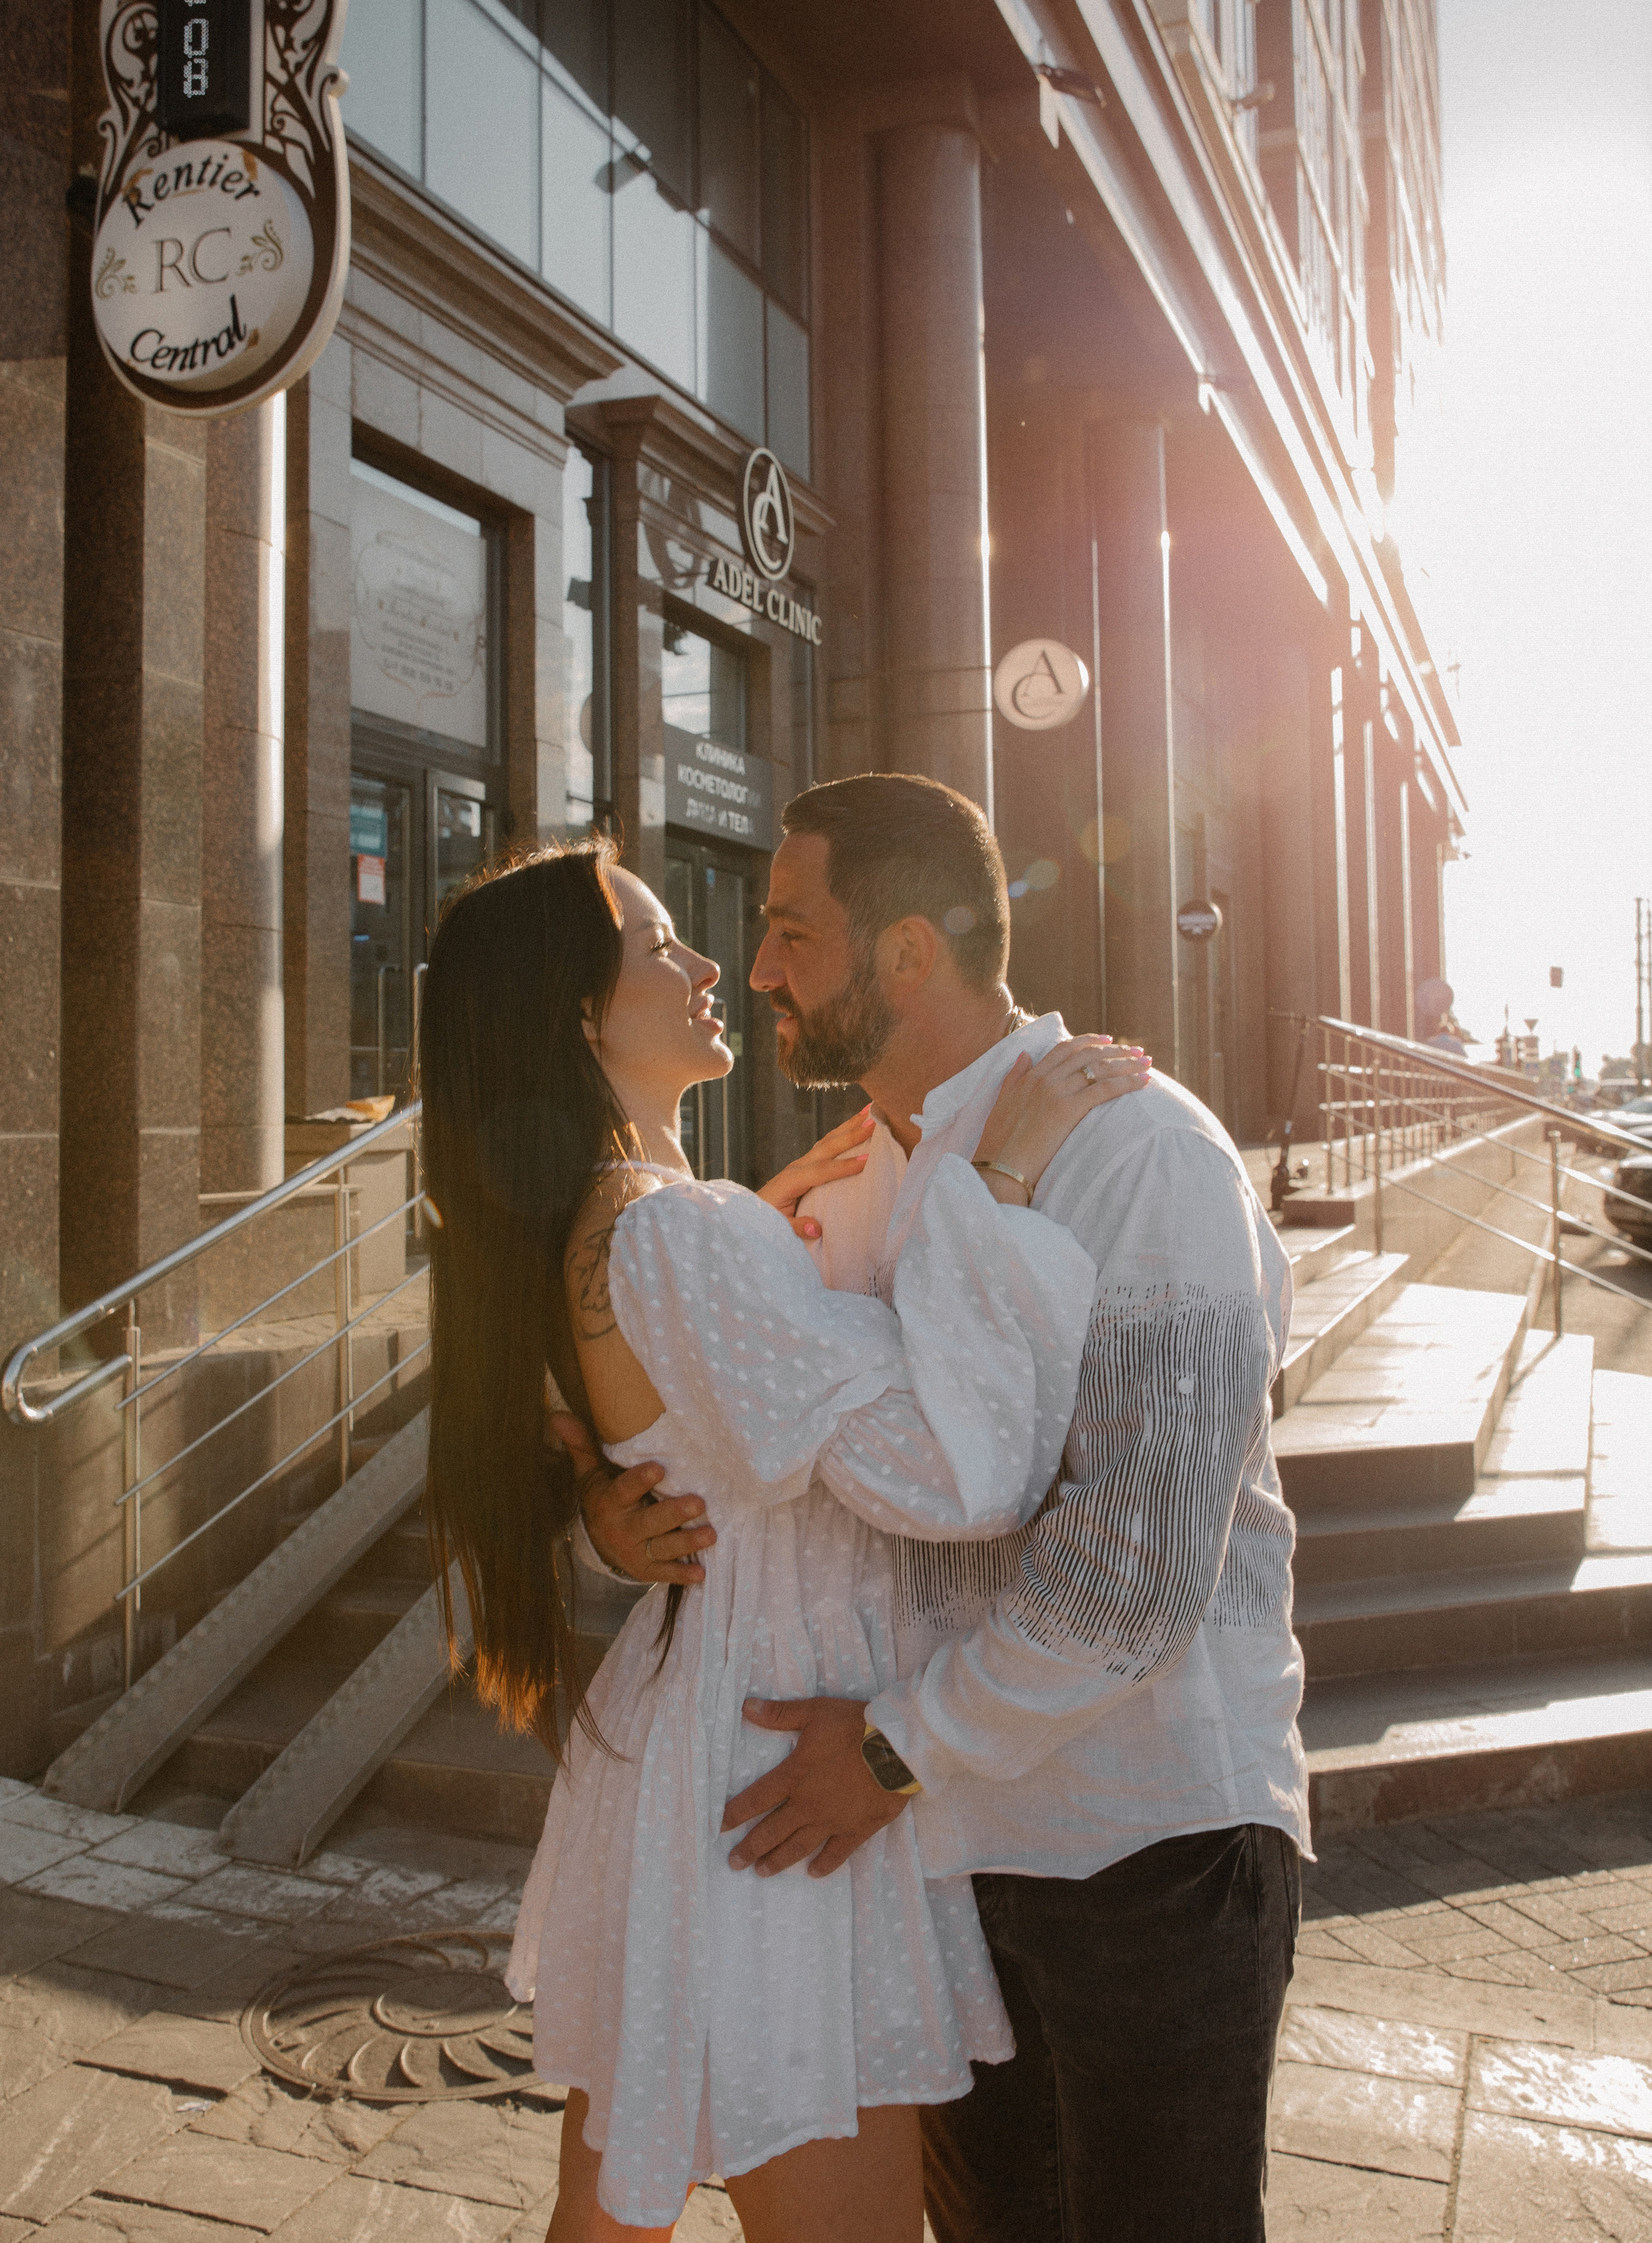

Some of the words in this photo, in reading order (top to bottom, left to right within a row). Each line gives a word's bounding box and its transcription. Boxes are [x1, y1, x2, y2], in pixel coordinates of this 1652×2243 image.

[122, 154, 261, 229] Rentier
[152, 227, 232, 293] RC
[130, 294, 247, 372] Central
[713, 558, 764, 613] ADEL
[767, 588, 822, 646] CLINIC
[696, 742, 746, 776] КЛИНИКА
